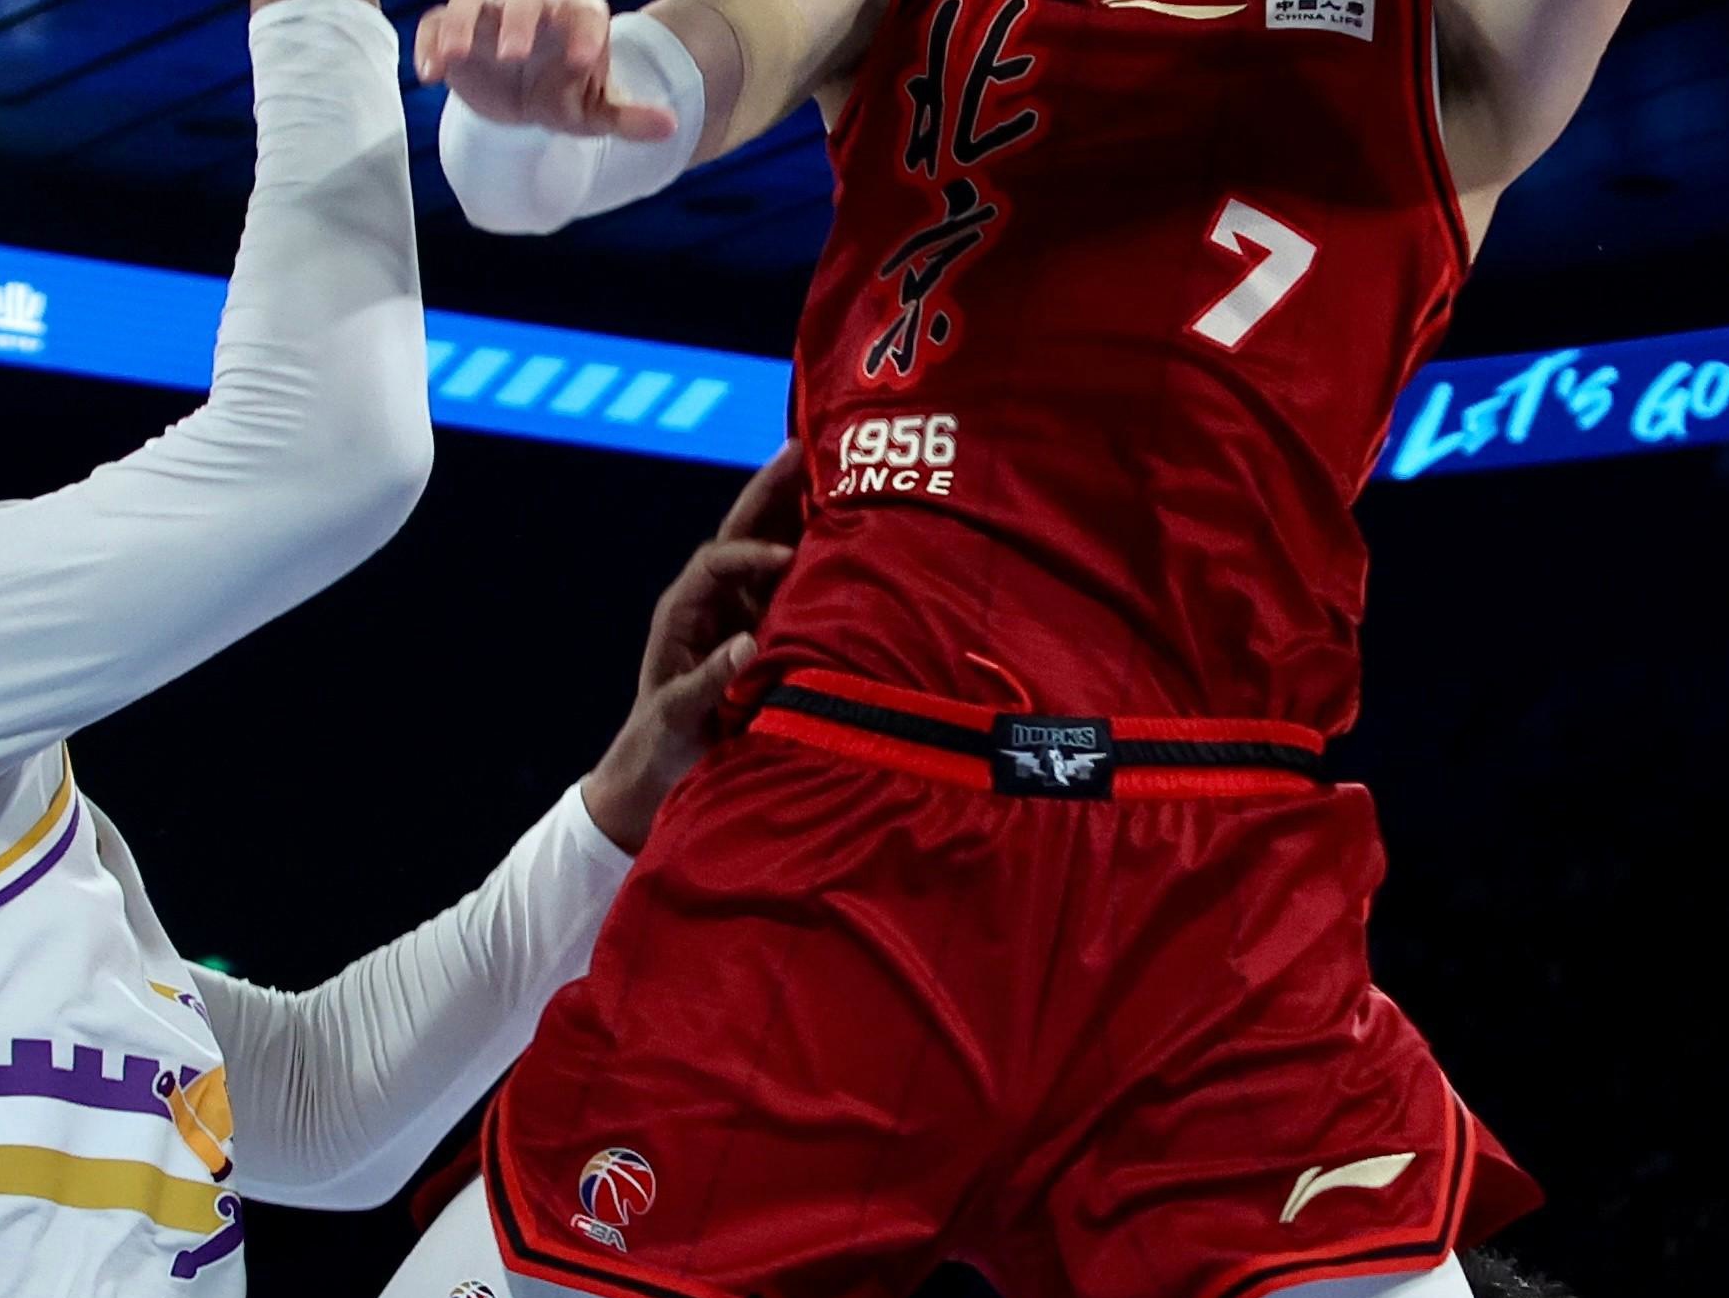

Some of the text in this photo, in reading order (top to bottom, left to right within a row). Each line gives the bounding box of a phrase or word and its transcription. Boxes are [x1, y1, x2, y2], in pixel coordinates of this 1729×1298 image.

[1190, 196, 1319, 350] 7
[840, 413, 958, 472] 1956
[570, 1213, 627, 1253] CBA
